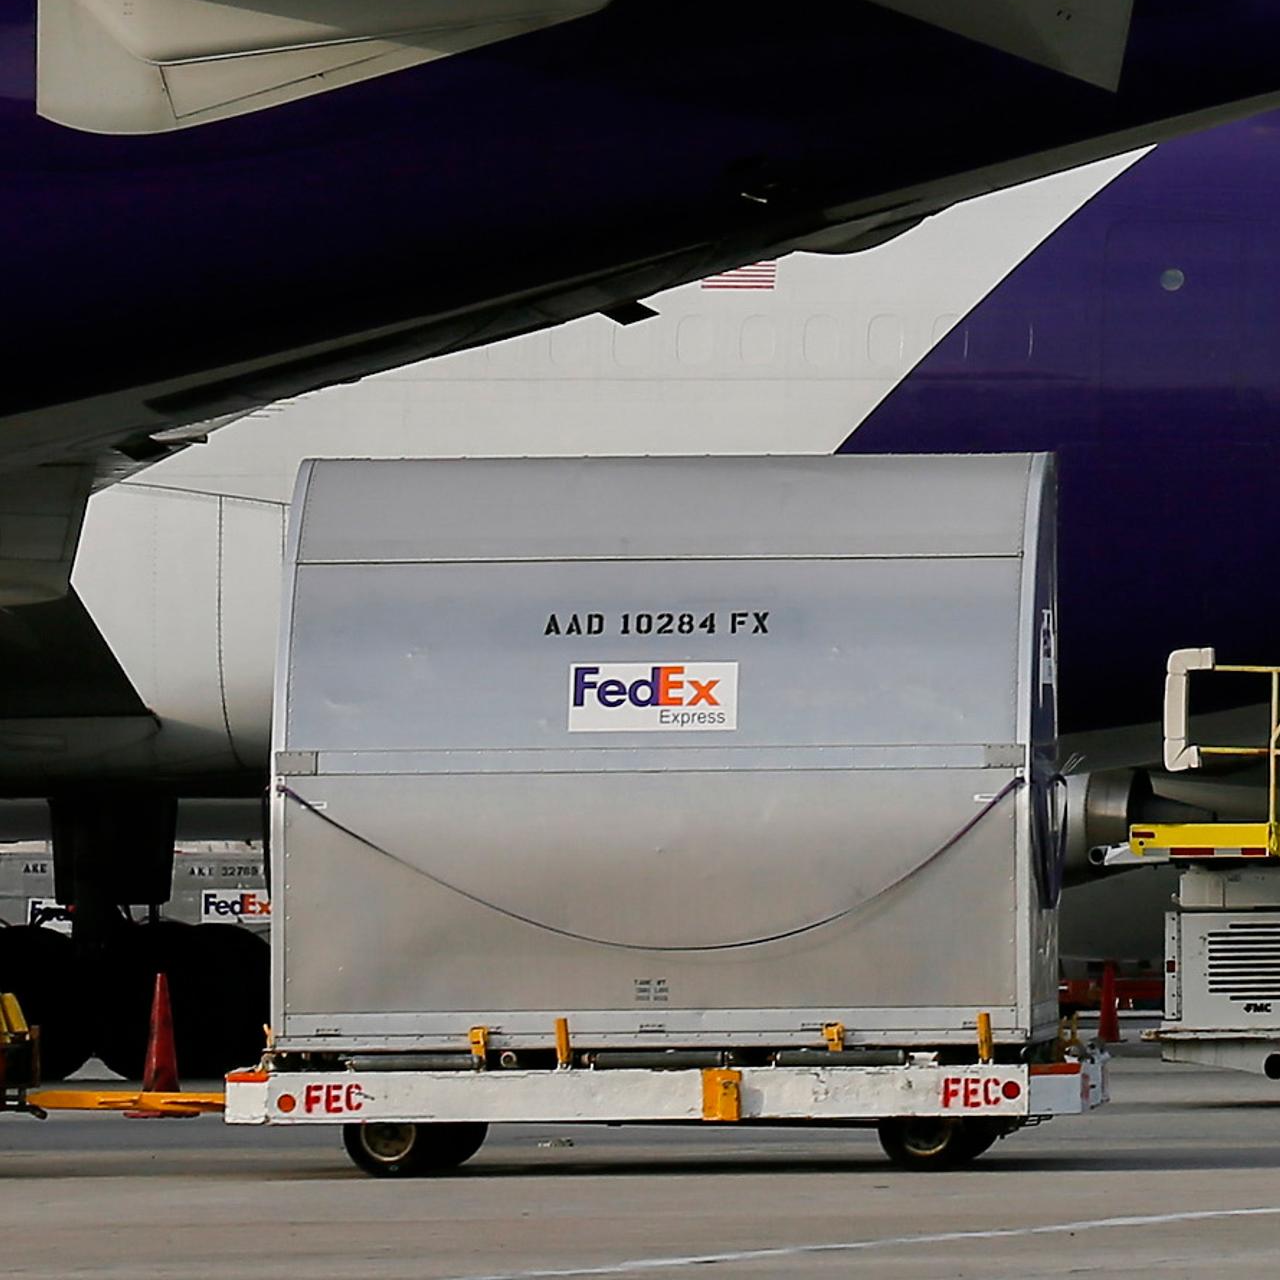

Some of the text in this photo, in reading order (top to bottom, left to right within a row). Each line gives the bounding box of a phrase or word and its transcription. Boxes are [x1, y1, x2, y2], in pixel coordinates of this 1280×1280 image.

[544, 612, 769, 635] AAD 10284 FX
[572, 665, 721, 708] FedEx
[659, 709, 726, 727] Express
[204, 893, 271, 916] FedEx
[304, 1083, 363, 1114] FEC
[940, 1077, 1001, 1108] FEC
